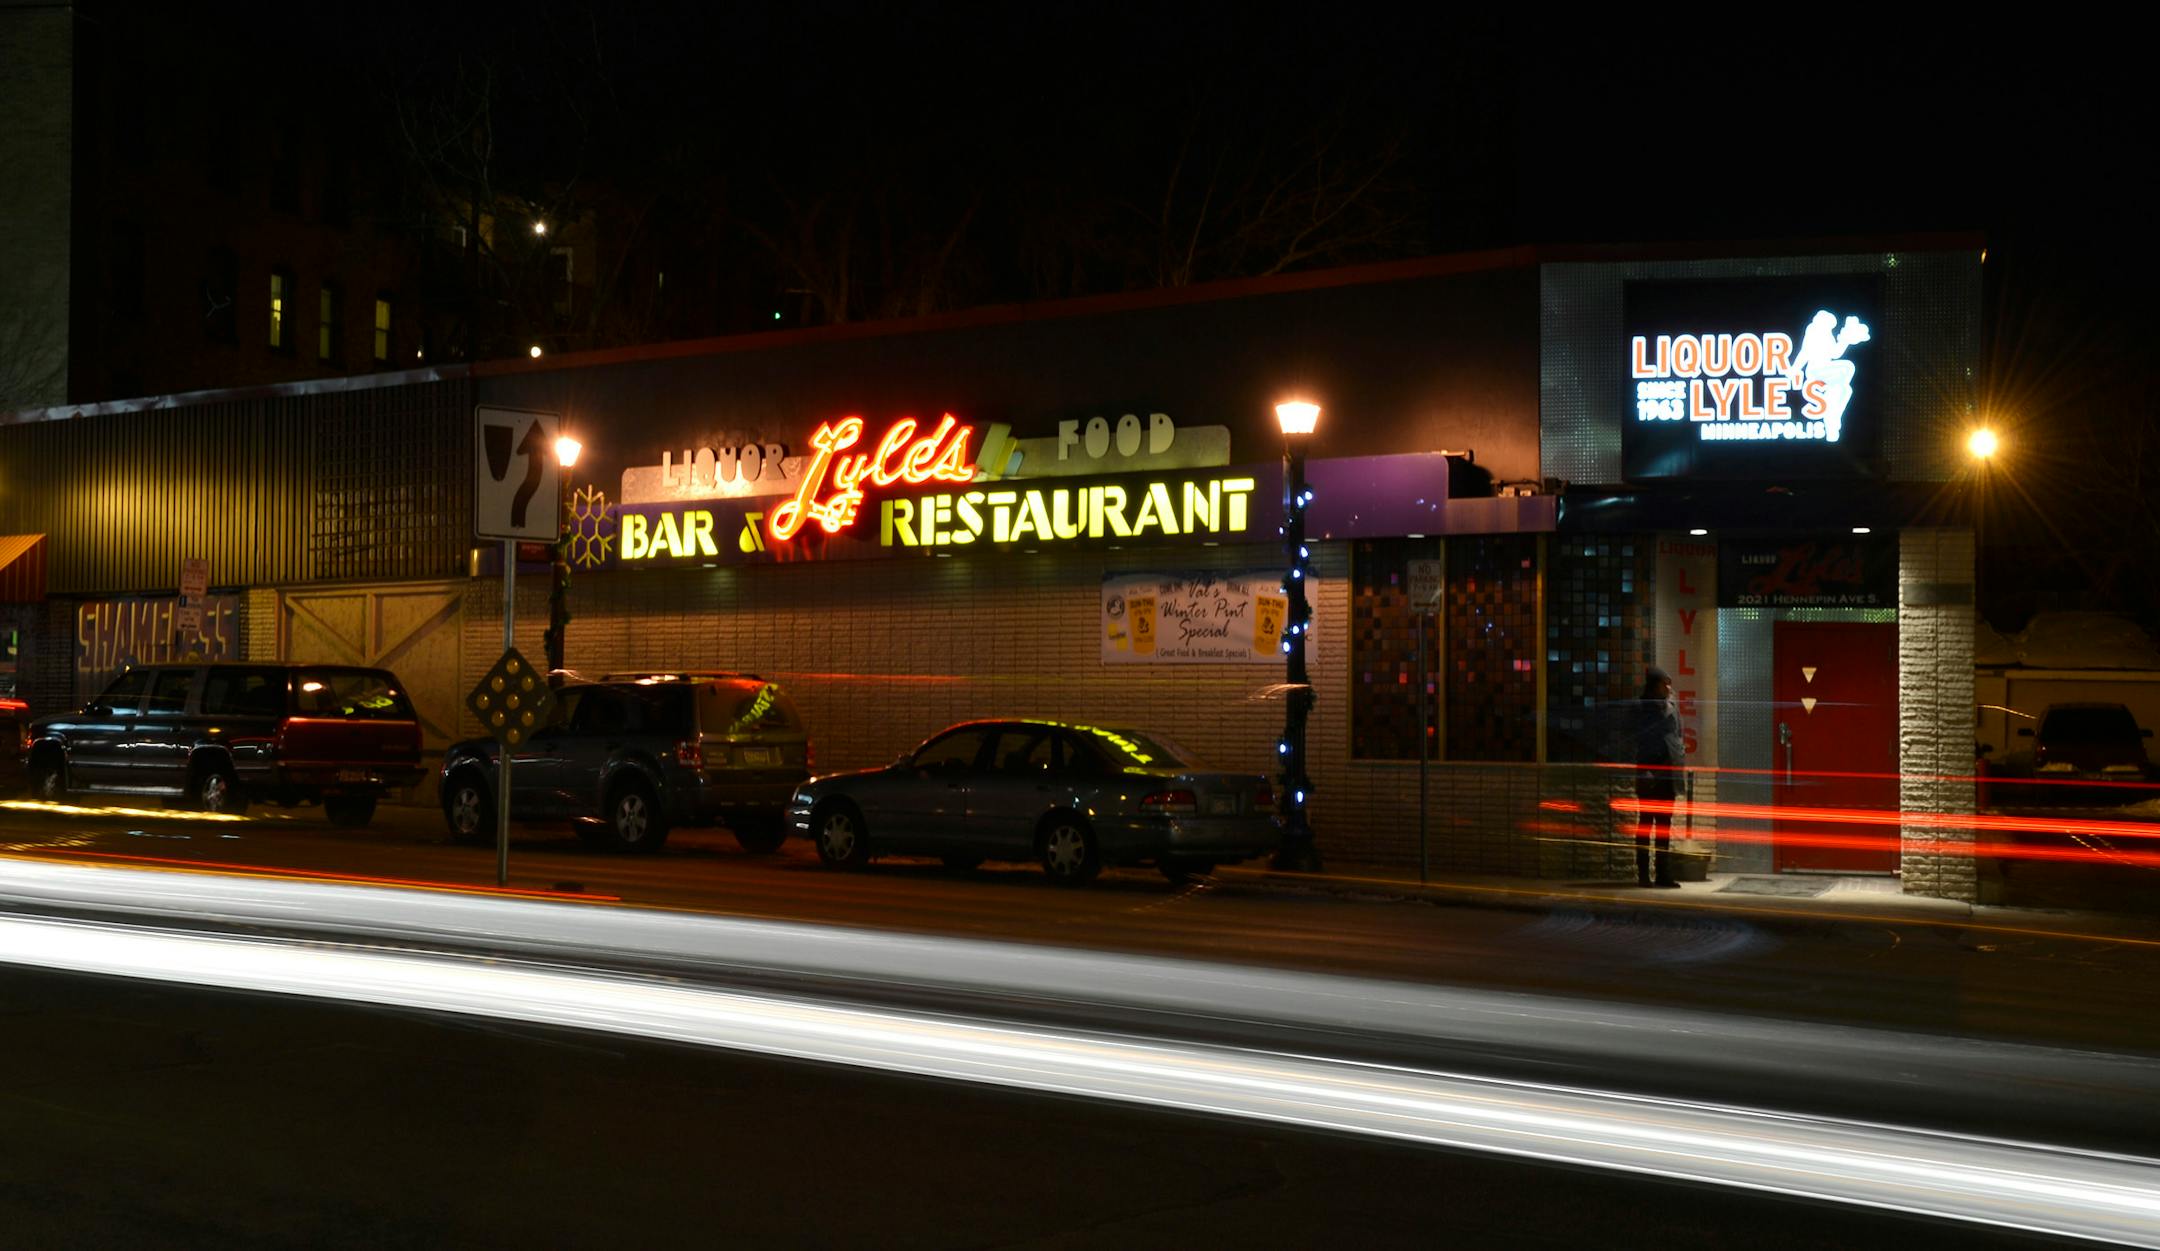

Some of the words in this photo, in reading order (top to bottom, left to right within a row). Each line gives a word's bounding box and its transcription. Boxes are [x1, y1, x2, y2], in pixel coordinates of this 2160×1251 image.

[1632, 333, 1793, 379] LIQUOR
[1690, 374, 1828, 422] LYLE'S
[1058, 412, 1175, 461] FOOD
[1700, 422, 1826, 441] MINNEAPOLIS
[661, 443, 787, 489] LIQUOR
[768, 411, 977, 541] Lyle's
[620, 509, 719, 560] BAR
[880, 477, 1255, 547] RESTAURANT
[1188, 578, 1221, 598] Val's
[1737, 594, 1768, 605] 2021
[1161, 598, 1209, 618] Winter
[1214, 598, 1249, 618] Pint
[1178, 618, 1231, 647] Special
